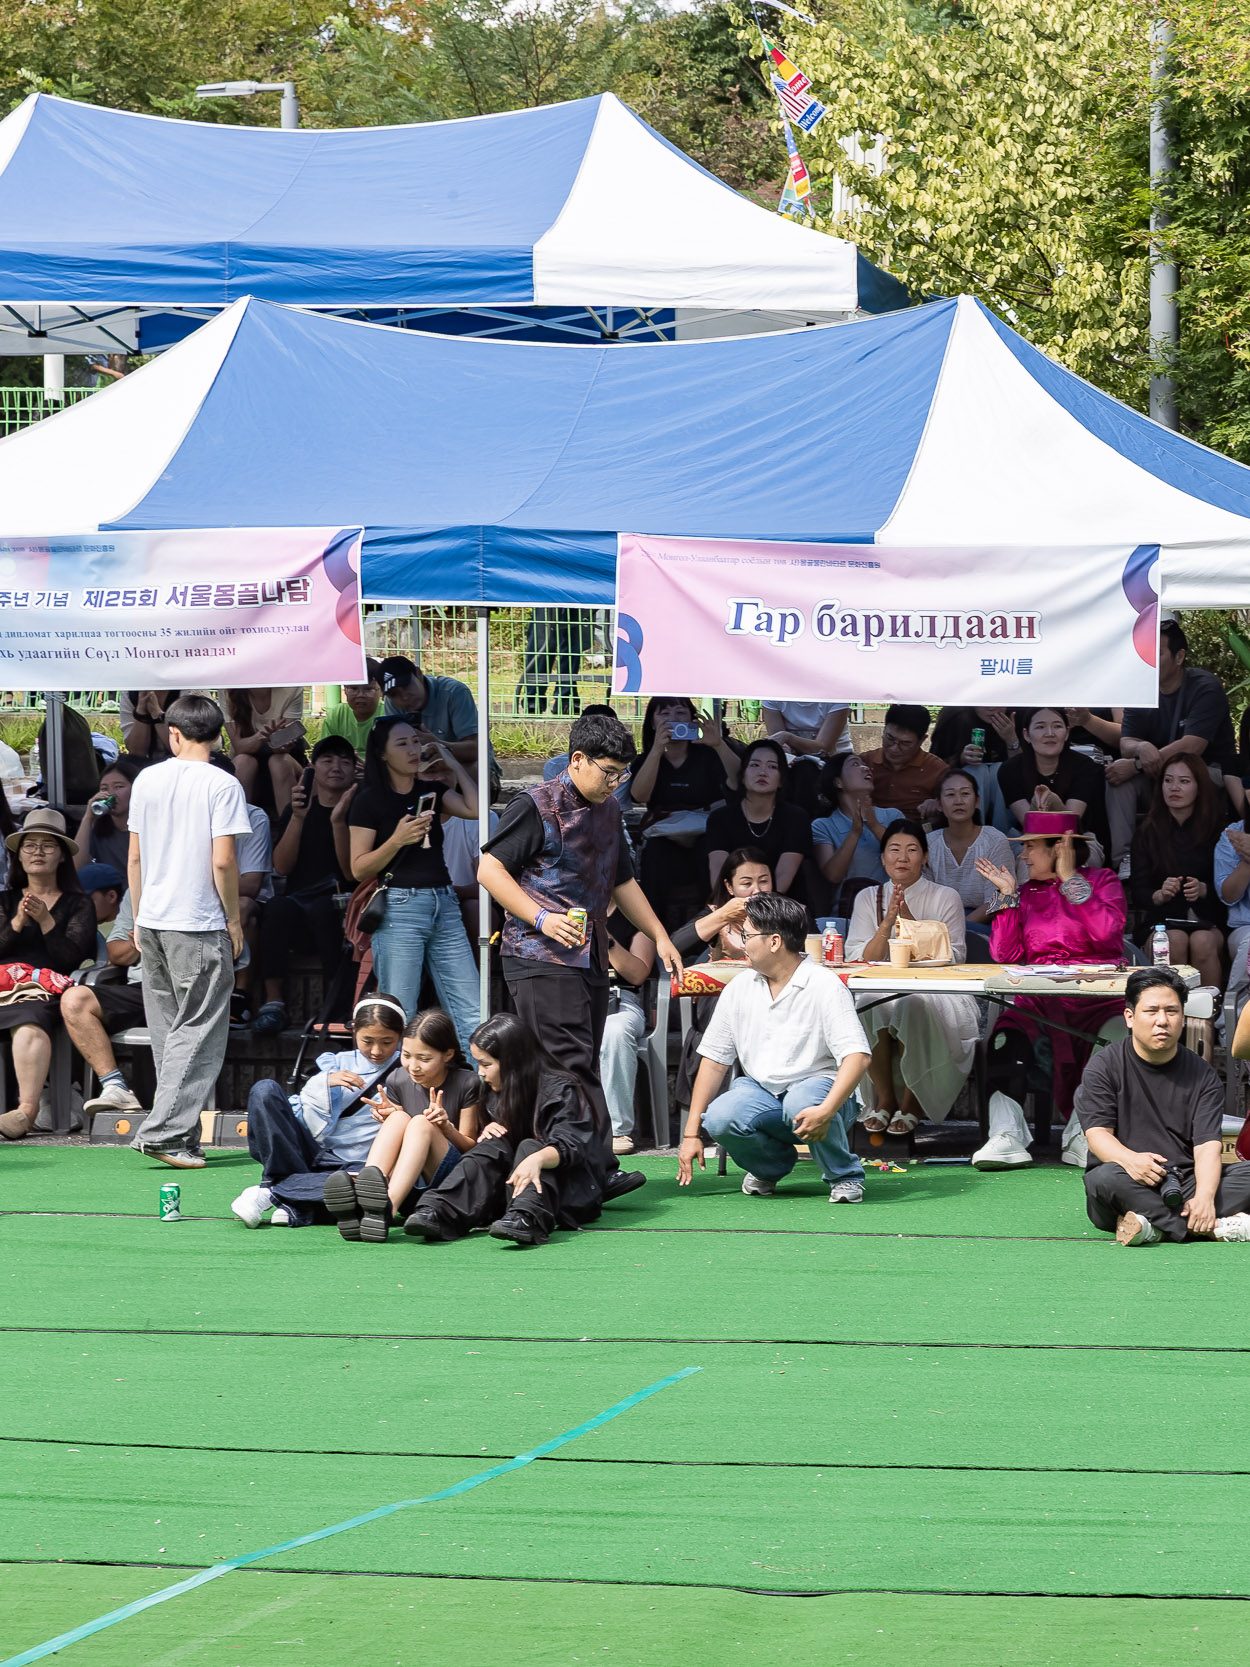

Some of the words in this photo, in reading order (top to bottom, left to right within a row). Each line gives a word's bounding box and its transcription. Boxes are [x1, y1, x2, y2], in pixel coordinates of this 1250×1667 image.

[35, 591, 69, 608] 기념
[83, 588, 158, 608] 제25회
[165, 578, 310, 608] 서울몽골나담
[55, 630, 101, 640] харилцаа
[105, 629, 157, 638] тогтоосны
[160, 628, 172, 637] 35
[174, 627, 216, 637] жилийн
[219, 625, 238, 636] ойг
[731, 601, 800, 643] Гар
[816, 603, 1037, 647] барилдаан
[18, 648, 80, 662] удаагийн
[85, 647, 120, 662] Сөүл
[124, 647, 180, 659] Монгол
[185, 647, 236, 658] наадам
[980, 658, 1033, 676] 팔씨름
